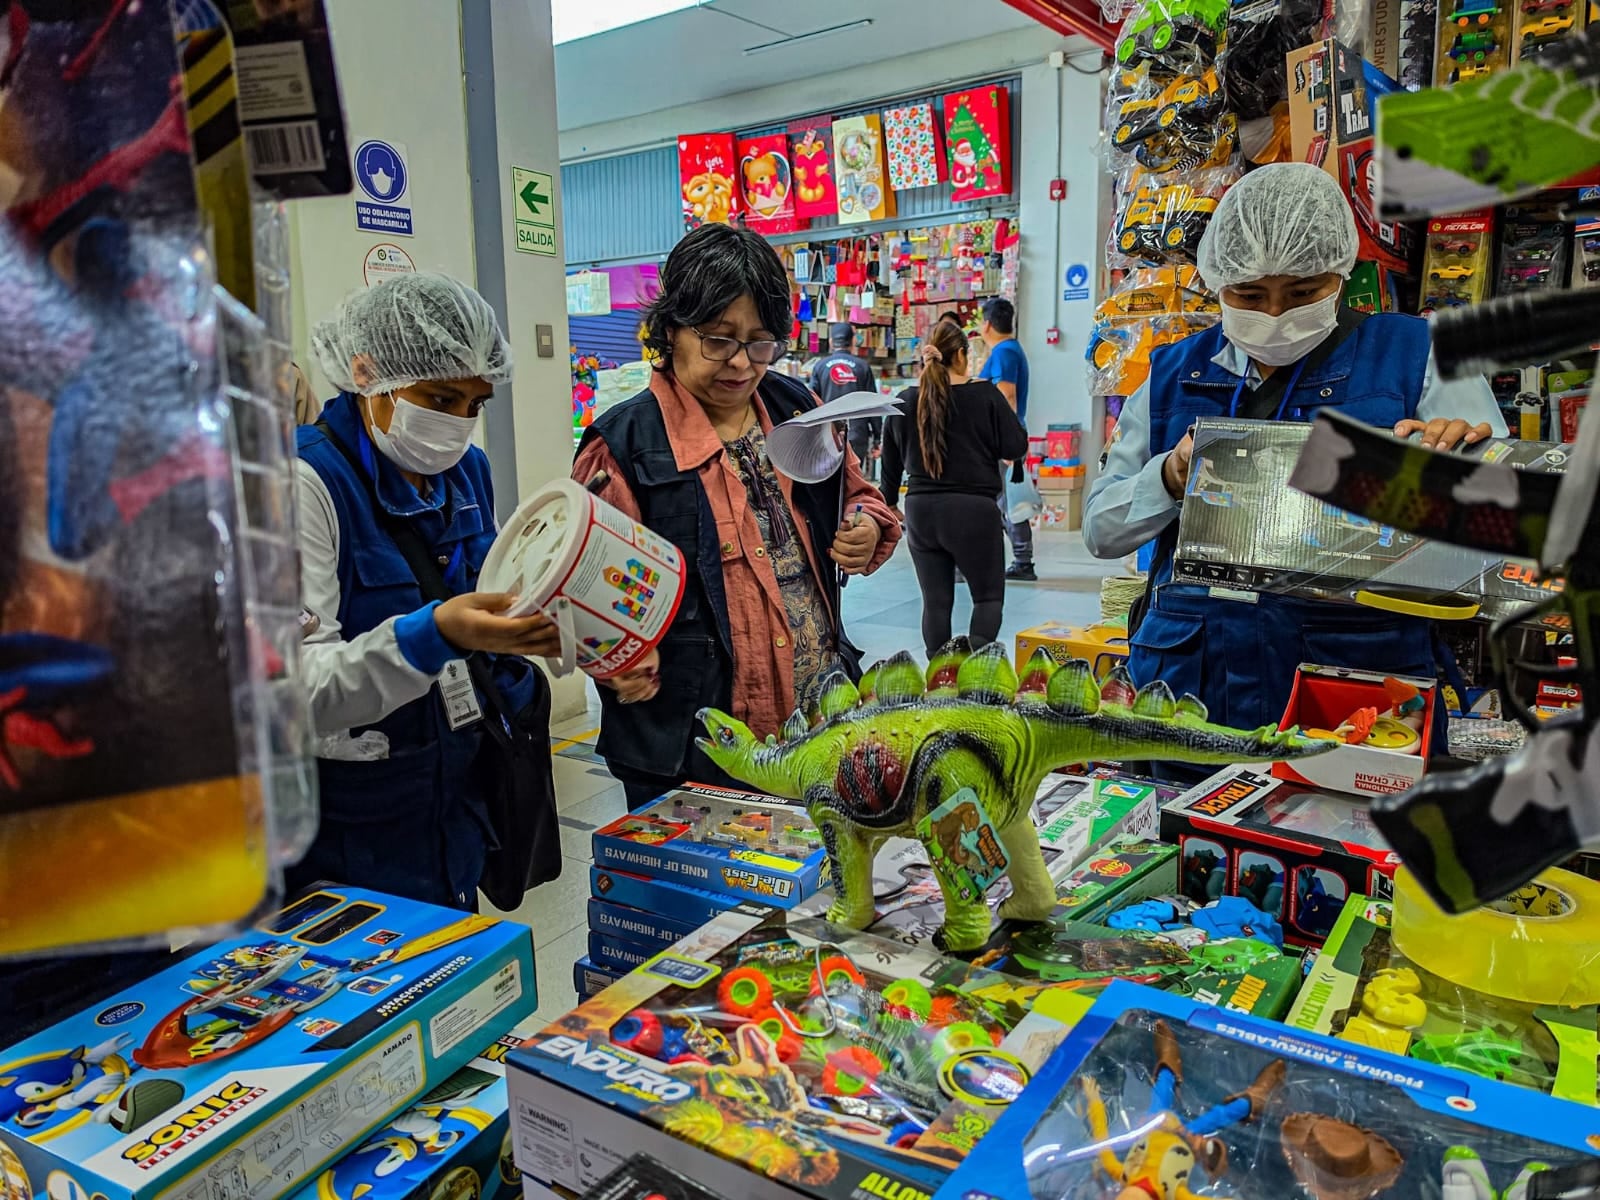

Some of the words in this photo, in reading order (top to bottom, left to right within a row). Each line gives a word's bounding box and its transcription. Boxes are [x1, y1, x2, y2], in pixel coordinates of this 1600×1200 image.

[358, 206, 371, 215] USO
[372, 208, 410, 221] OBLIGATORIO
[362, 216, 371, 225] DE
[371, 218, 408, 230] MASCARILLA
[519, 229, 554, 247] SALIDA
[1355, 772, 1389, 785] CHAIN
[1193, 781, 1256, 816] TRUCK
[604, 848, 661, 868] HIGHWAYS
[664, 861, 679, 872] OF
[681, 865, 708, 879] KING
[600, 914, 655, 937] HIGHWAYS
[658, 929, 673, 941] OF
[376, 955, 466, 1014] ESTACIONAMIENTO
[382, 1033, 413, 1059] ARMADO
[1216, 1023, 1341, 1065] ARTICULABLES
[536, 1035, 692, 1101] ENDURO
[1343, 1060, 1424, 1089] FIGURAS
[121, 1080, 256, 1164] SONIC
[528, 1107, 569, 1134] WARNING:
